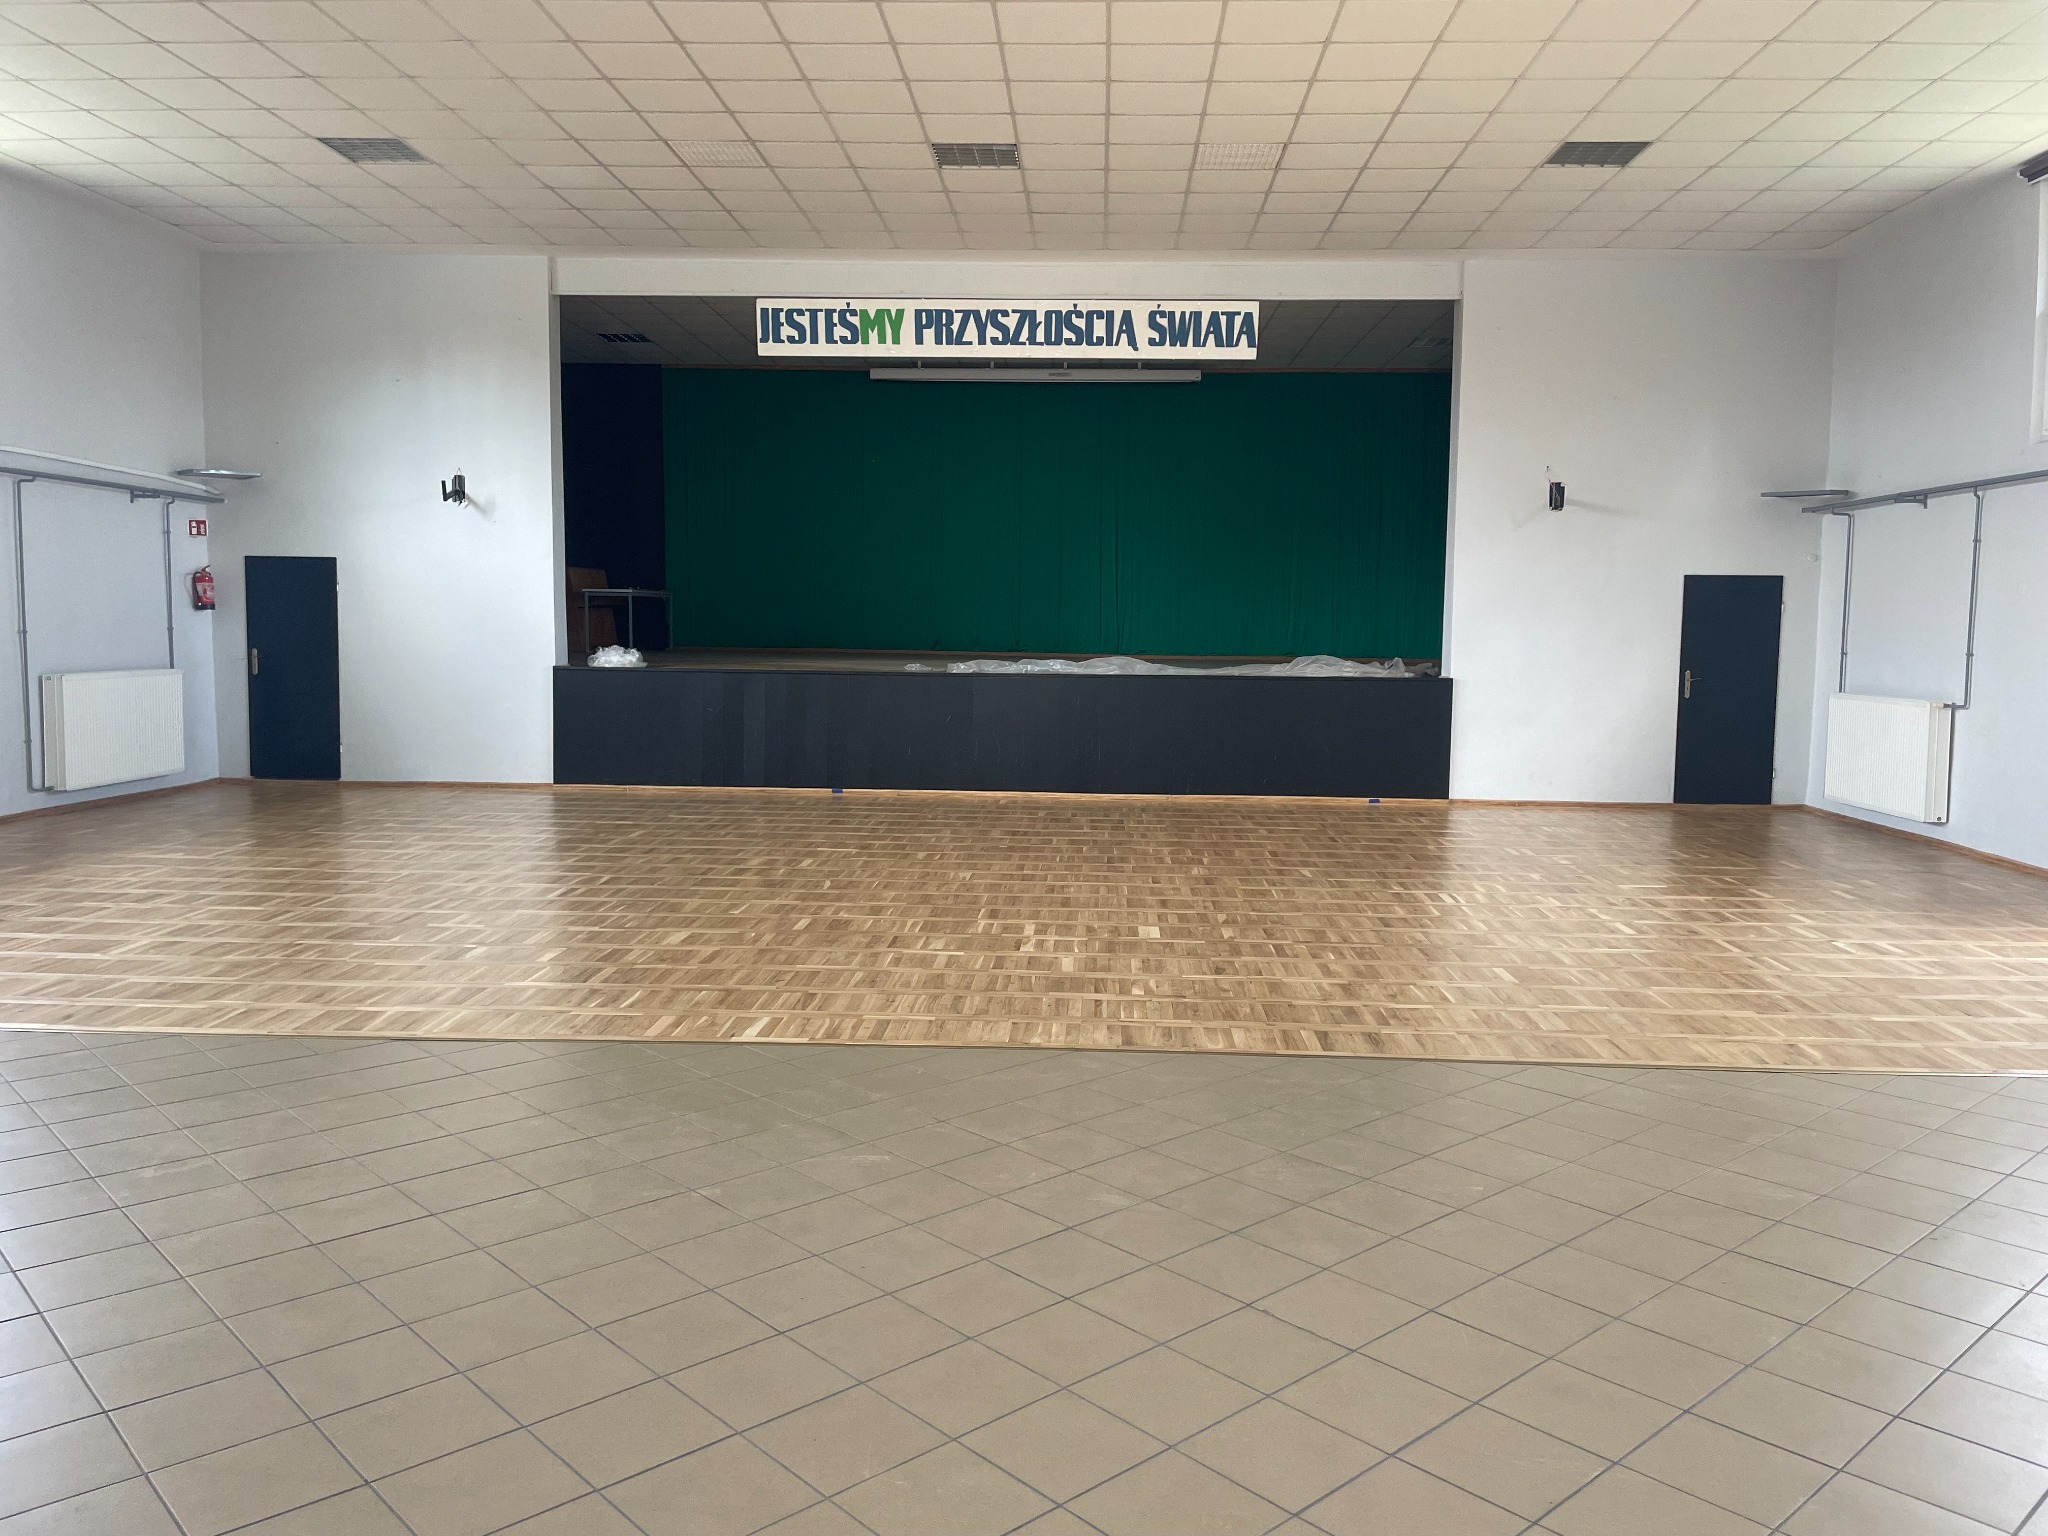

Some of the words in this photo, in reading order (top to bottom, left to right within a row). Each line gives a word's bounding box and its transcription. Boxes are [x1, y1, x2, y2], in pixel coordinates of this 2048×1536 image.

[759, 302, 904, 345] JESTEŚMY
[914, 303, 1139, 351] PRZYSZŁOŚCIĄ
[1147, 304, 1257, 348] ŚWIATA
